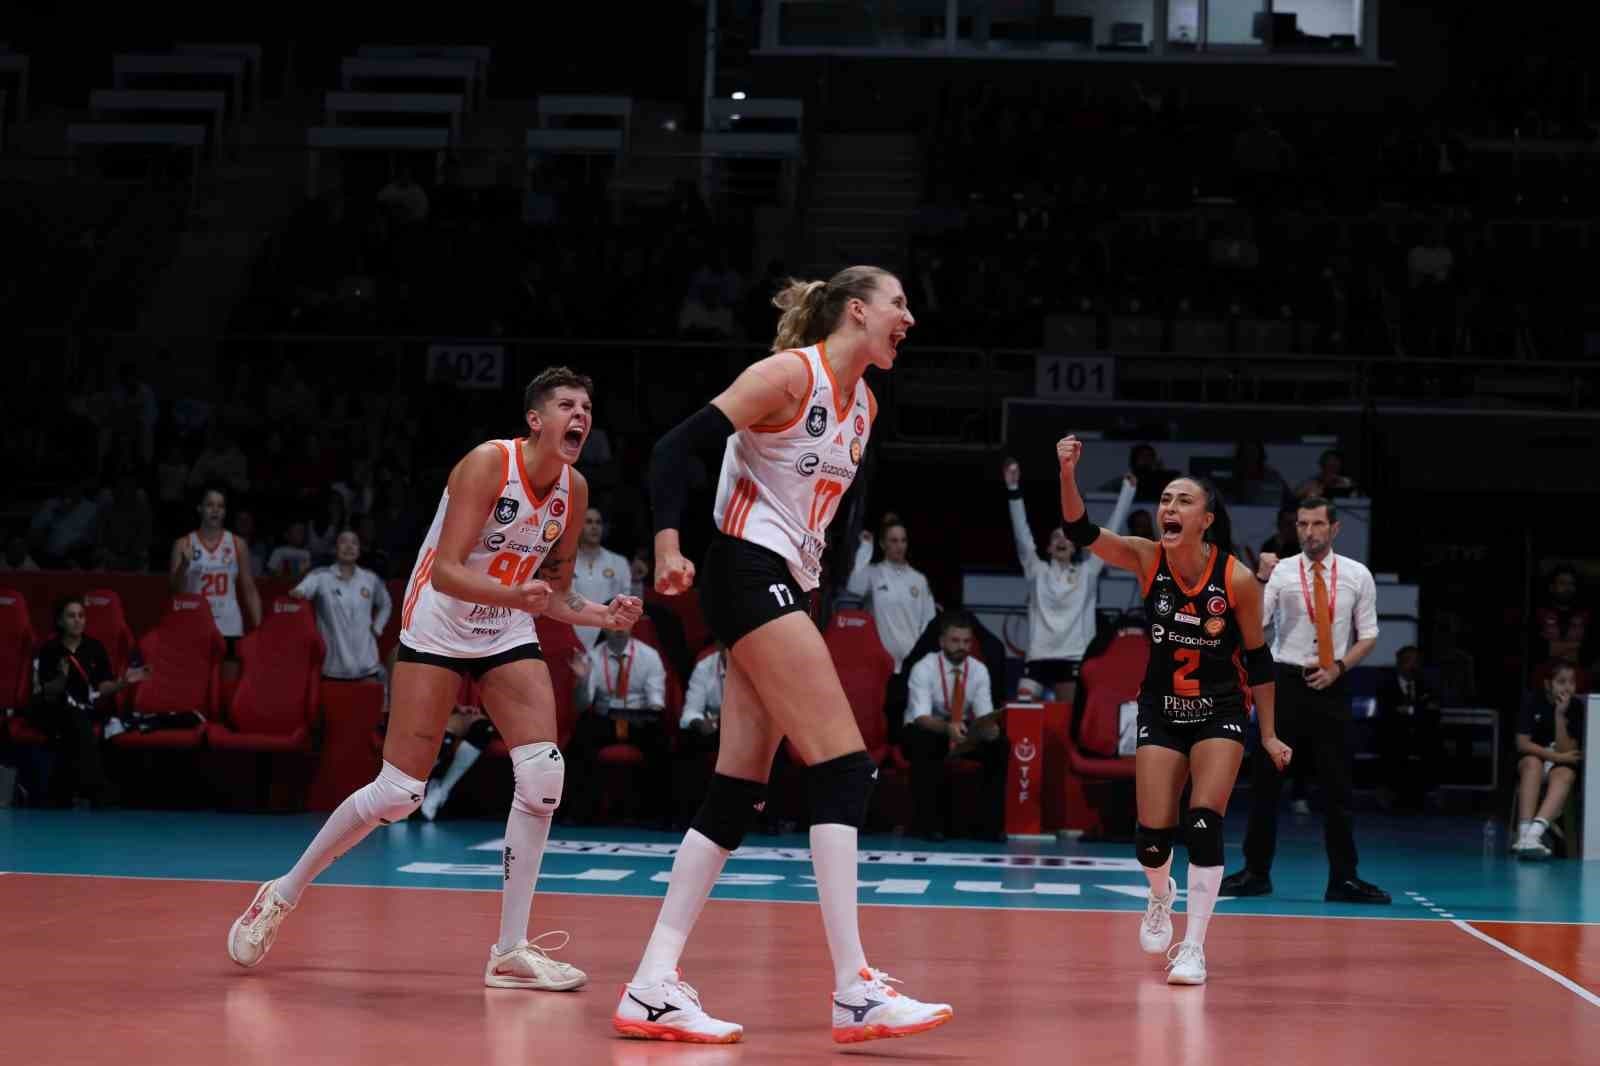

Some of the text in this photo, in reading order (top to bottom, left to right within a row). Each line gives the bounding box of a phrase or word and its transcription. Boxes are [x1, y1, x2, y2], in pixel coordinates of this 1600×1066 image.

[1047, 363, 1103, 392] 101
[808, 479, 842, 529] 17
[201, 573, 228, 596] 20
[488, 552, 538, 586] 91
[768, 583, 794, 607] 17
[1172, 647, 1201, 698] 2
[1163, 695, 1214, 711] PERON
[1018, 765, 1031, 806] TVF
